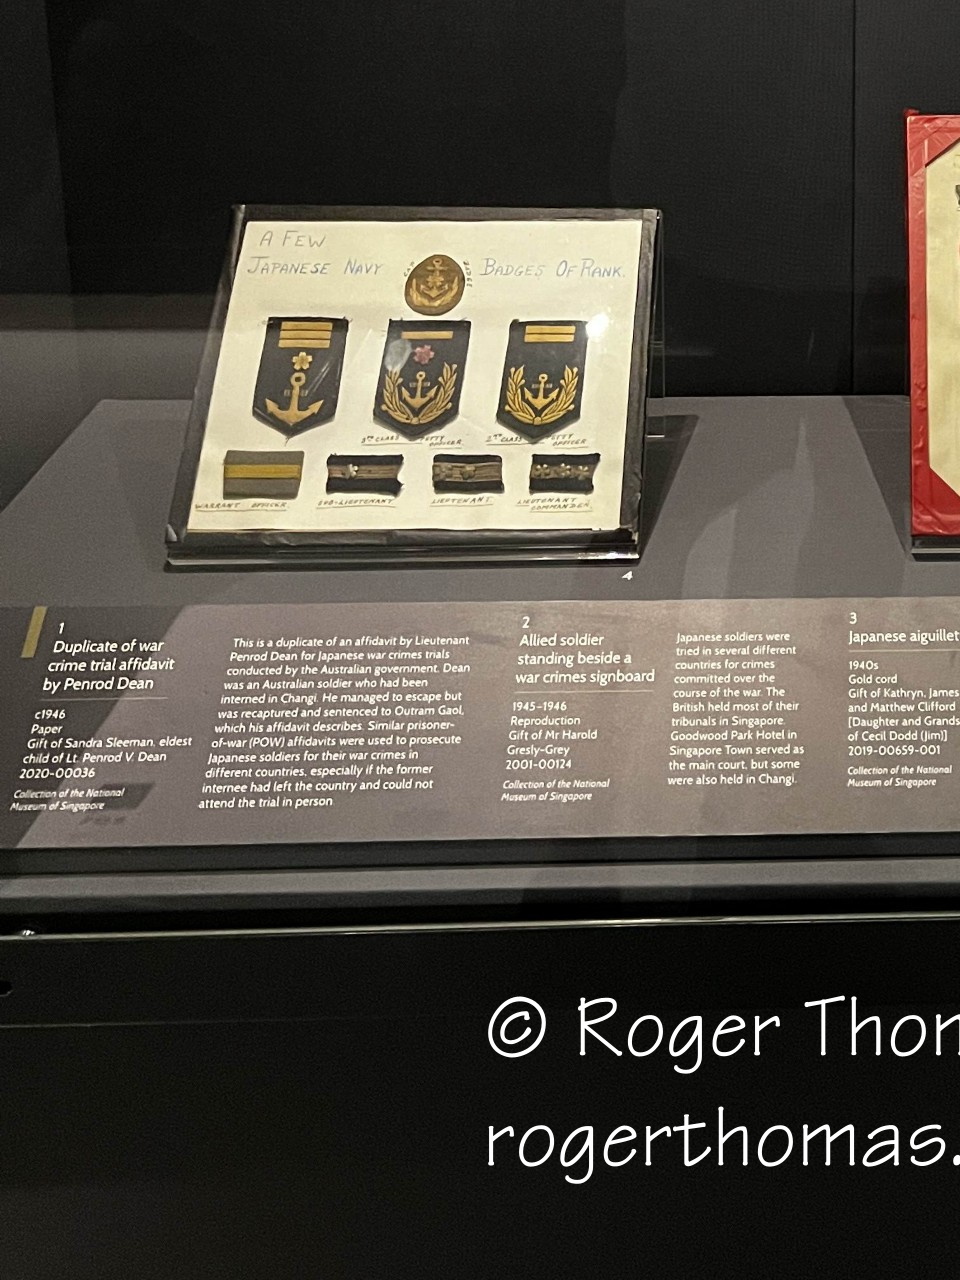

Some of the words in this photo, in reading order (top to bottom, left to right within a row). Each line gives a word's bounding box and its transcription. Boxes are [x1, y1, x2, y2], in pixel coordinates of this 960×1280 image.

[259, 230, 274, 247] A
[282, 230, 326, 248] FEW
[247, 256, 331, 275] JAPANESE
[344, 257, 383, 275] NAVY
[480, 258, 547, 278] BADGES
[556, 259, 575, 277] OF
[521, 615, 531, 629] 2
[849, 611, 858, 625] 3
[58, 621, 65, 635] 1
[233, 637, 254, 648] This
[256, 638, 265, 648] is
[266, 639, 274, 648] a
[275, 636, 324, 650] duplicate
[325, 636, 338, 647] of
[338, 638, 353, 647] an
[354, 635, 398, 647] affidavit
[398, 635, 414, 649] by
[414, 635, 470, 646] Lieutenant
[518, 633, 558, 647] Allied
[559, 632, 605, 647] soldier
[675, 632, 723, 644] Japanese
[724, 631, 764, 642] soldiers
[765, 633, 791, 641] were
[848, 630, 907, 646] Japanese
[52, 639, 119, 657] Duplicate
[120, 638, 138, 653] of
[138, 641, 165, 652] war
[47, 658, 87, 673] crime
[89, 657, 118, 672] trial
[118, 656, 176, 672] affidavit
[517, 651, 575, 669] standing
[577, 650, 621, 665] beside
[623, 653, 632, 664] a
[848, 660, 879, 671] 1940s
[515, 673, 541, 684] war
[542, 670, 587, 684] crimes
[589, 668, 655, 687] signboard
[848, 673, 873, 685] Gold
[874, 673, 898, 684] cord
[42, 676, 62, 695] by
[63, 676, 115, 691] Penrod
[116, 676, 154, 690] Dean
[847, 687, 868, 699] Gift
[869, 687, 882, 699] of
[928, 687, 960, 700] James
[34, 708, 66, 720] c1946
[847, 701, 868, 713] and
[869, 701, 916, 713] Matthew
[917, 701, 956, 712] Clifford
[510, 715, 581, 728] Reproduction
[901, 715, 922, 727] and
[30, 723, 64, 736] Paper
[508, 729, 529, 741] Gift
[530, 729, 543, 741] of
[544, 729, 560, 740] Mr
[561, 728, 598, 740] Harold
[847, 730, 859, 742] of
[861, 730, 887, 742] Cecil
[888, 729, 918, 741] Dodd
[26, 737, 49, 750] Gift
[50, 737, 64, 749] of
[63, 737, 103, 749] Sandra
[158, 735, 193, 747] eldest
[506, 744, 571, 758] Gresly-Grey
[847, 744, 941, 757] 2019-00659-001
[22, 751, 51, 765] child
[51, 751, 65, 764] of
[81, 751, 124, 764] Penrod
[137, 751, 167, 762] Dean
[505, 758, 572, 770] 2001-00124
[18, 766, 96, 780] 2020-00036
